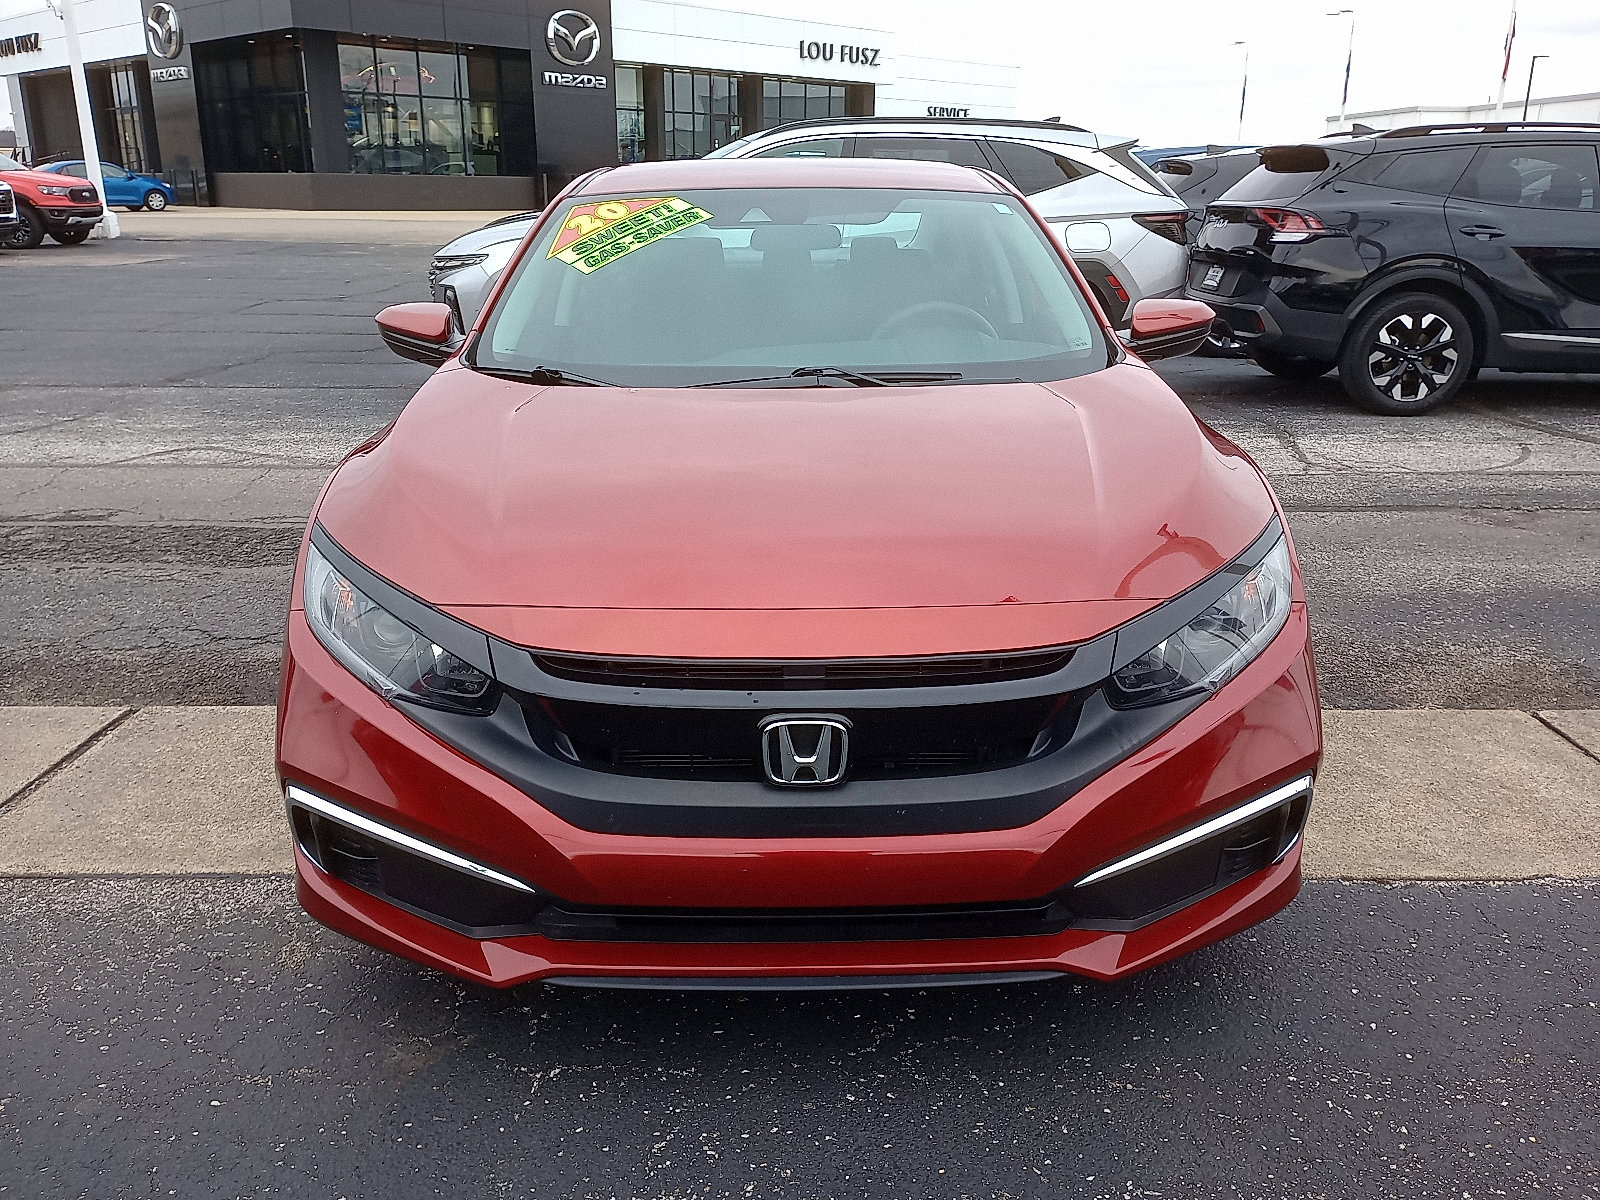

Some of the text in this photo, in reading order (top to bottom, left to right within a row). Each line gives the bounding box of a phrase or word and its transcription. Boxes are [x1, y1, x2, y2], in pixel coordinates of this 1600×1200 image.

[0, 38, 15, 57] OU
[800, 40, 880, 66] LOU FUSZ
[926, 106, 970, 118] SERVICE
[566, 202, 631, 236] 20
[571, 204, 677, 256] SWEET!
[584, 210, 704, 268] GAS-SAVER
